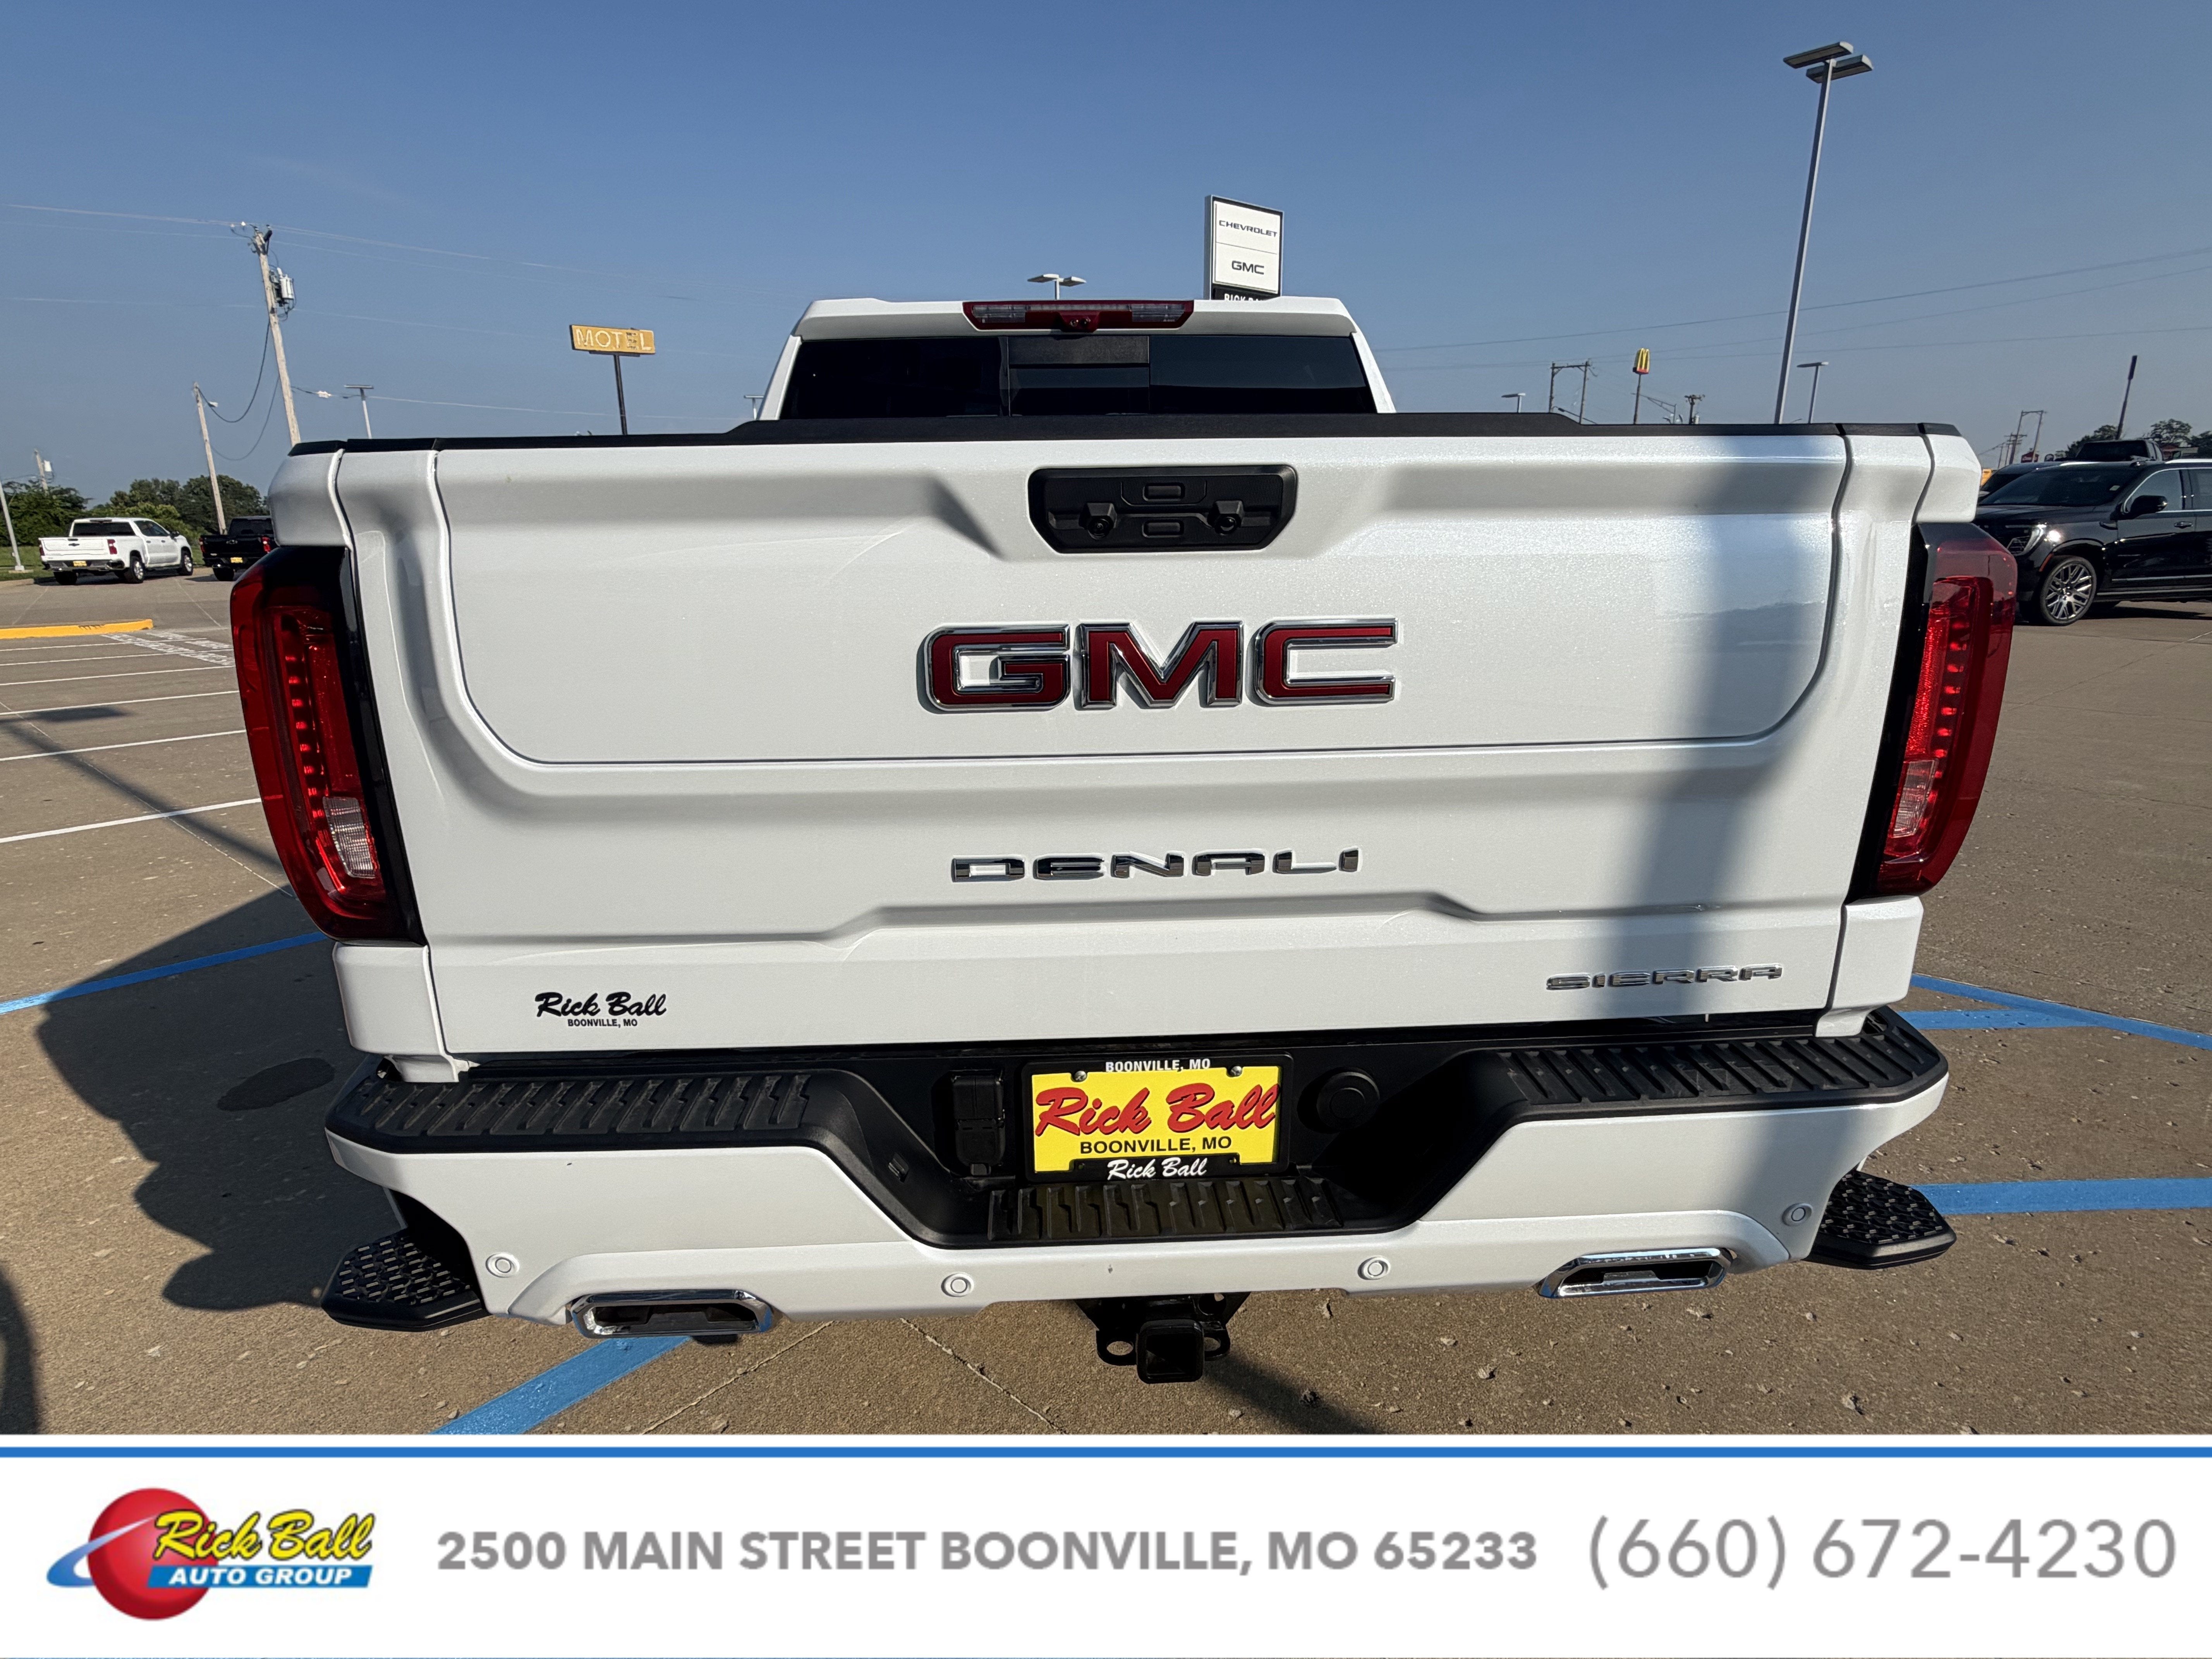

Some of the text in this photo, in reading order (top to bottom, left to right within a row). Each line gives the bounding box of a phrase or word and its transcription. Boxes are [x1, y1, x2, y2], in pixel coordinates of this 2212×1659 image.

[1219, 220, 1277, 237] CHEVROLET
[1231, 260, 1264, 275] GMC
[575, 328, 651, 350] MOTEL
[916, 618, 1398, 714] GMC
[951, 848, 1359, 882] DENALI
[1546, 963, 1783, 990] SIERRA
[535, 991, 667, 1017] Rick Ball
[567, 1018, 637, 1028] BOONVILLE, MO
[1105, 1058, 1211, 1072] BOONVILLE, MO
[1035, 1082, 1280, 1136] Rick Ball
[1080, 1136, 1232, 1154] BOONVILLE, MO
[1107, 1157, 1208, 1180] Rick Ball
